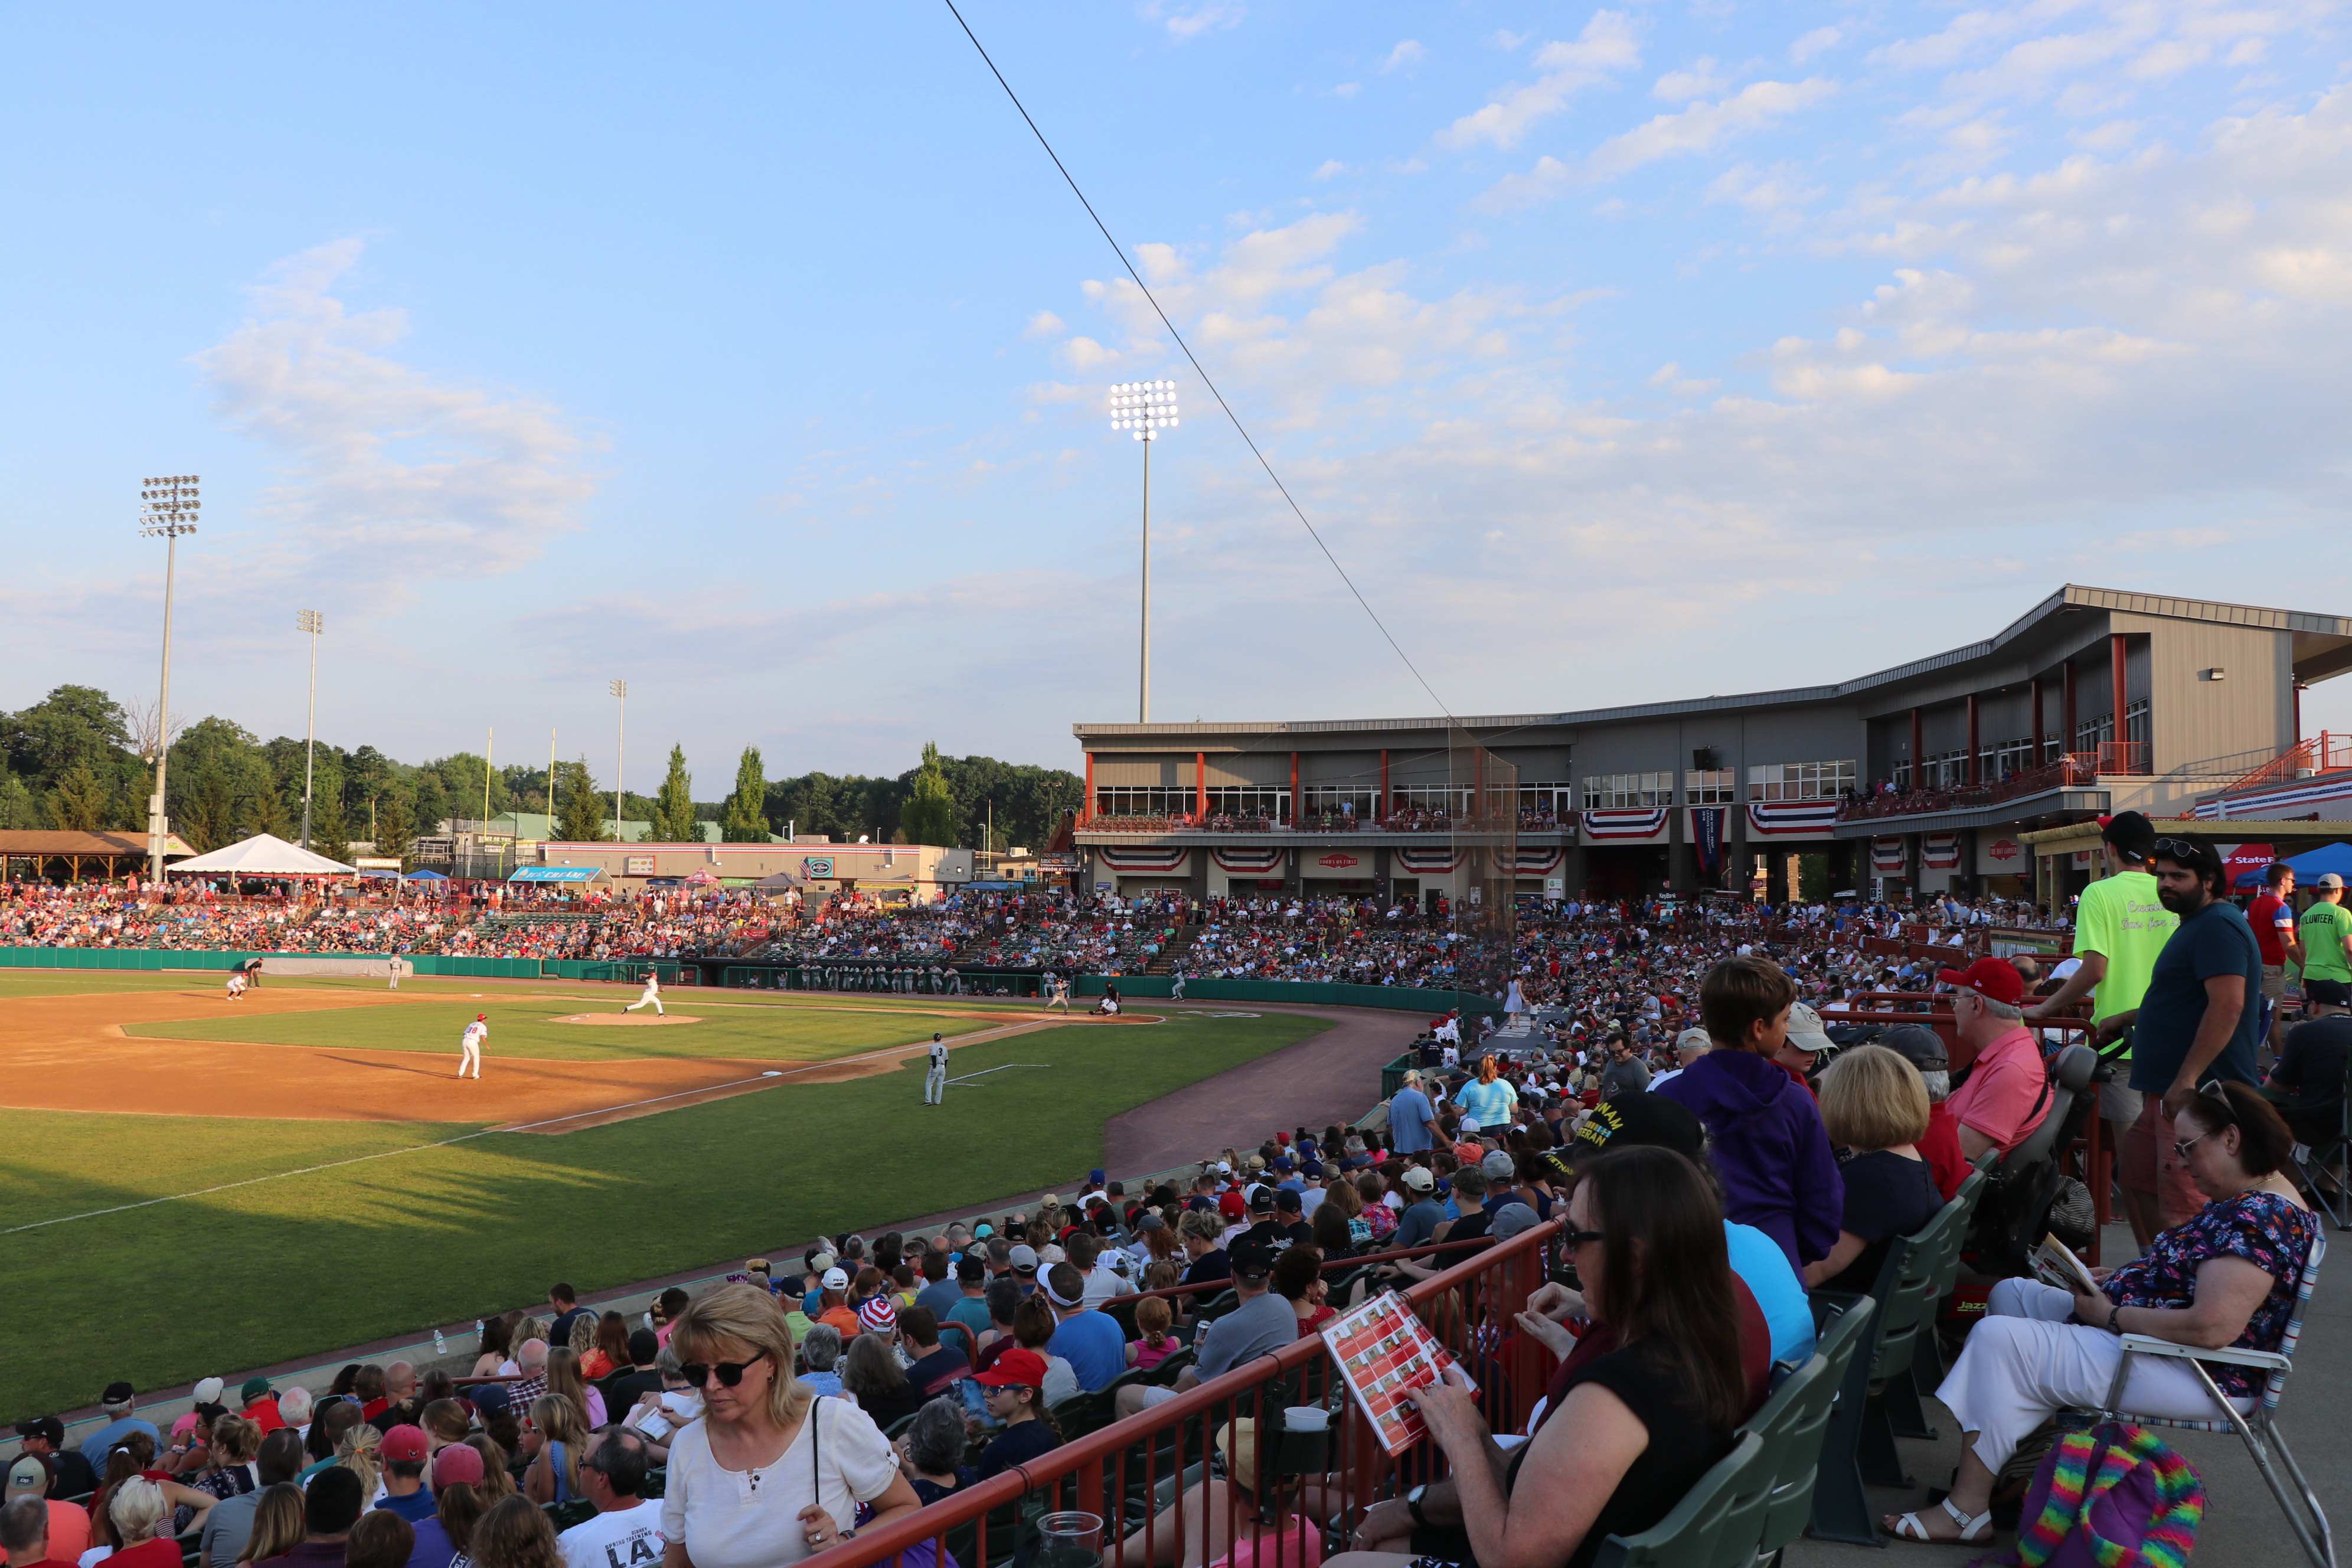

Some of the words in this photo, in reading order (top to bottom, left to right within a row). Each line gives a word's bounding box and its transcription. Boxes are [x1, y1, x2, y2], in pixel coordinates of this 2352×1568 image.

[2235, 856, 2274, 864] StateF
[2128, 900, 2167, 913] Creati
[2121, 917, 2144, 930] Fans
[2148, 916, 2167, 931] for
[2171, 915, 2181, 926] Li
[938, 1047, 943, 1057] 3
[1447, 1056, 1453, 1064] 18
[631, 1527, 648, 1535] DISNEY
[605, 1539, 625, 1550] SPRING
[626, 1530, 652, 1543] TRAINING
